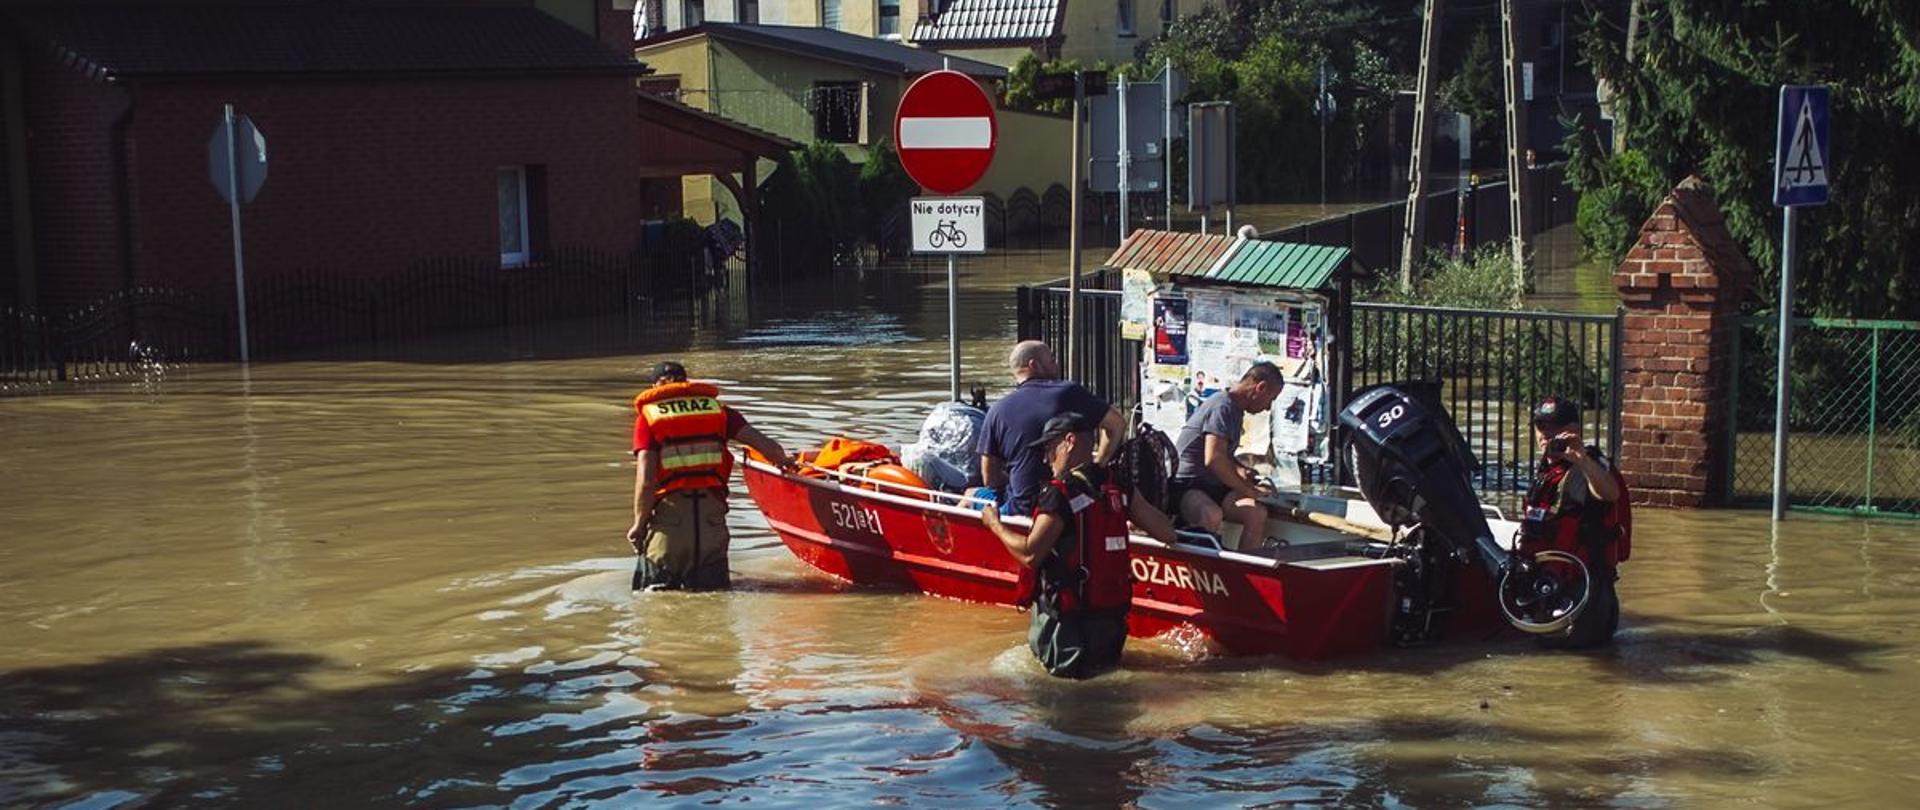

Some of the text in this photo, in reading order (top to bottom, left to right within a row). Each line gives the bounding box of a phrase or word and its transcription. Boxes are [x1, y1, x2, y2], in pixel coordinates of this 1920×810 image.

[913, 202, 981, 218] Nie dotyczy
[1378, 405, 1404, 428] 30
[1130, 555, 1230, 597] OŻARNA
